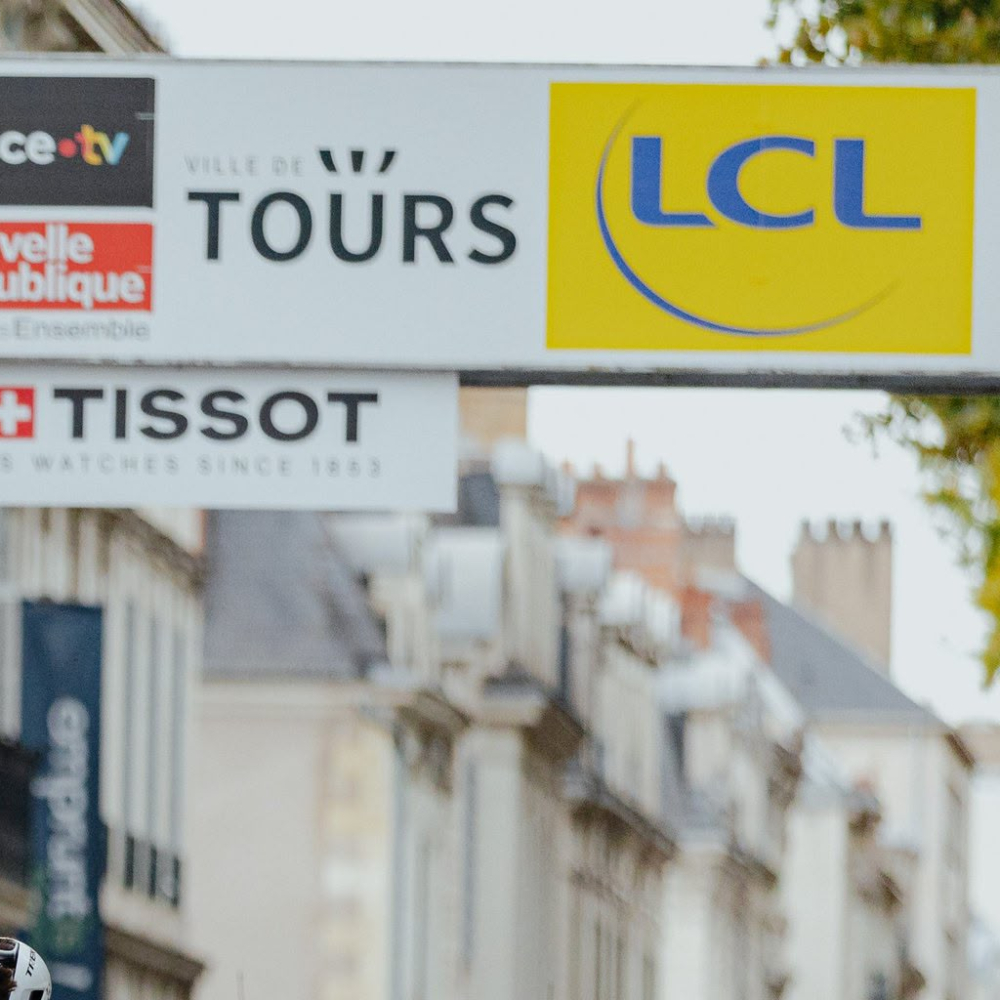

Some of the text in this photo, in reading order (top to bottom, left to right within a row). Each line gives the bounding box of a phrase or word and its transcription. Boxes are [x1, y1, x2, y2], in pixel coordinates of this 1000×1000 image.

[185, 155, 305, 176] VILLE DE
[630, 135, 923, 231] LCL
[186, 190, 519, 265] TOURS
[53, 388, 379, 443] TISSOT
[32, 454, 180, 475] WATCHES
[199, 455, 293, 477] SINCE
[312, 457, 382, 479] 1853
